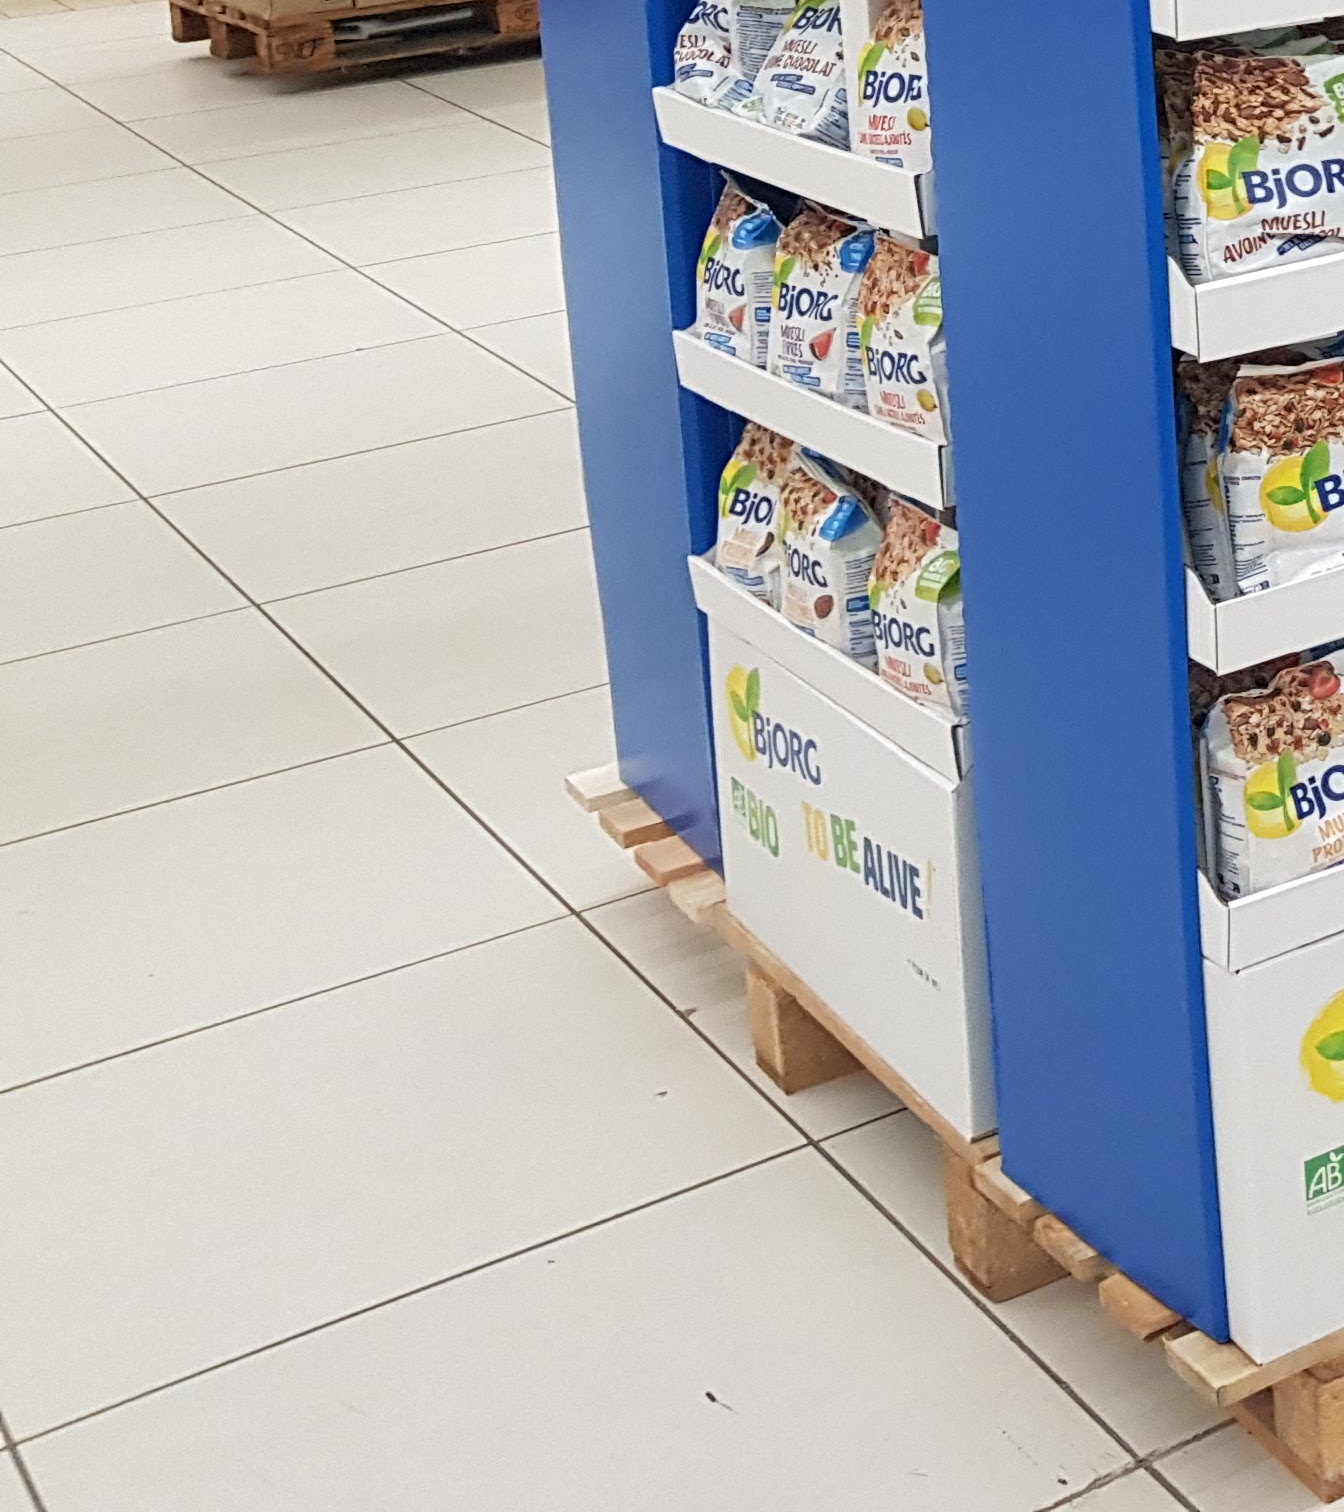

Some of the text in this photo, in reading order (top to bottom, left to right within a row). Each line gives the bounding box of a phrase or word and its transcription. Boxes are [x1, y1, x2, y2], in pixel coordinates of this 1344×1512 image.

[746, 794, 780, 858] BIO
[802, 800, 924, 920] TO BE ALIVE
